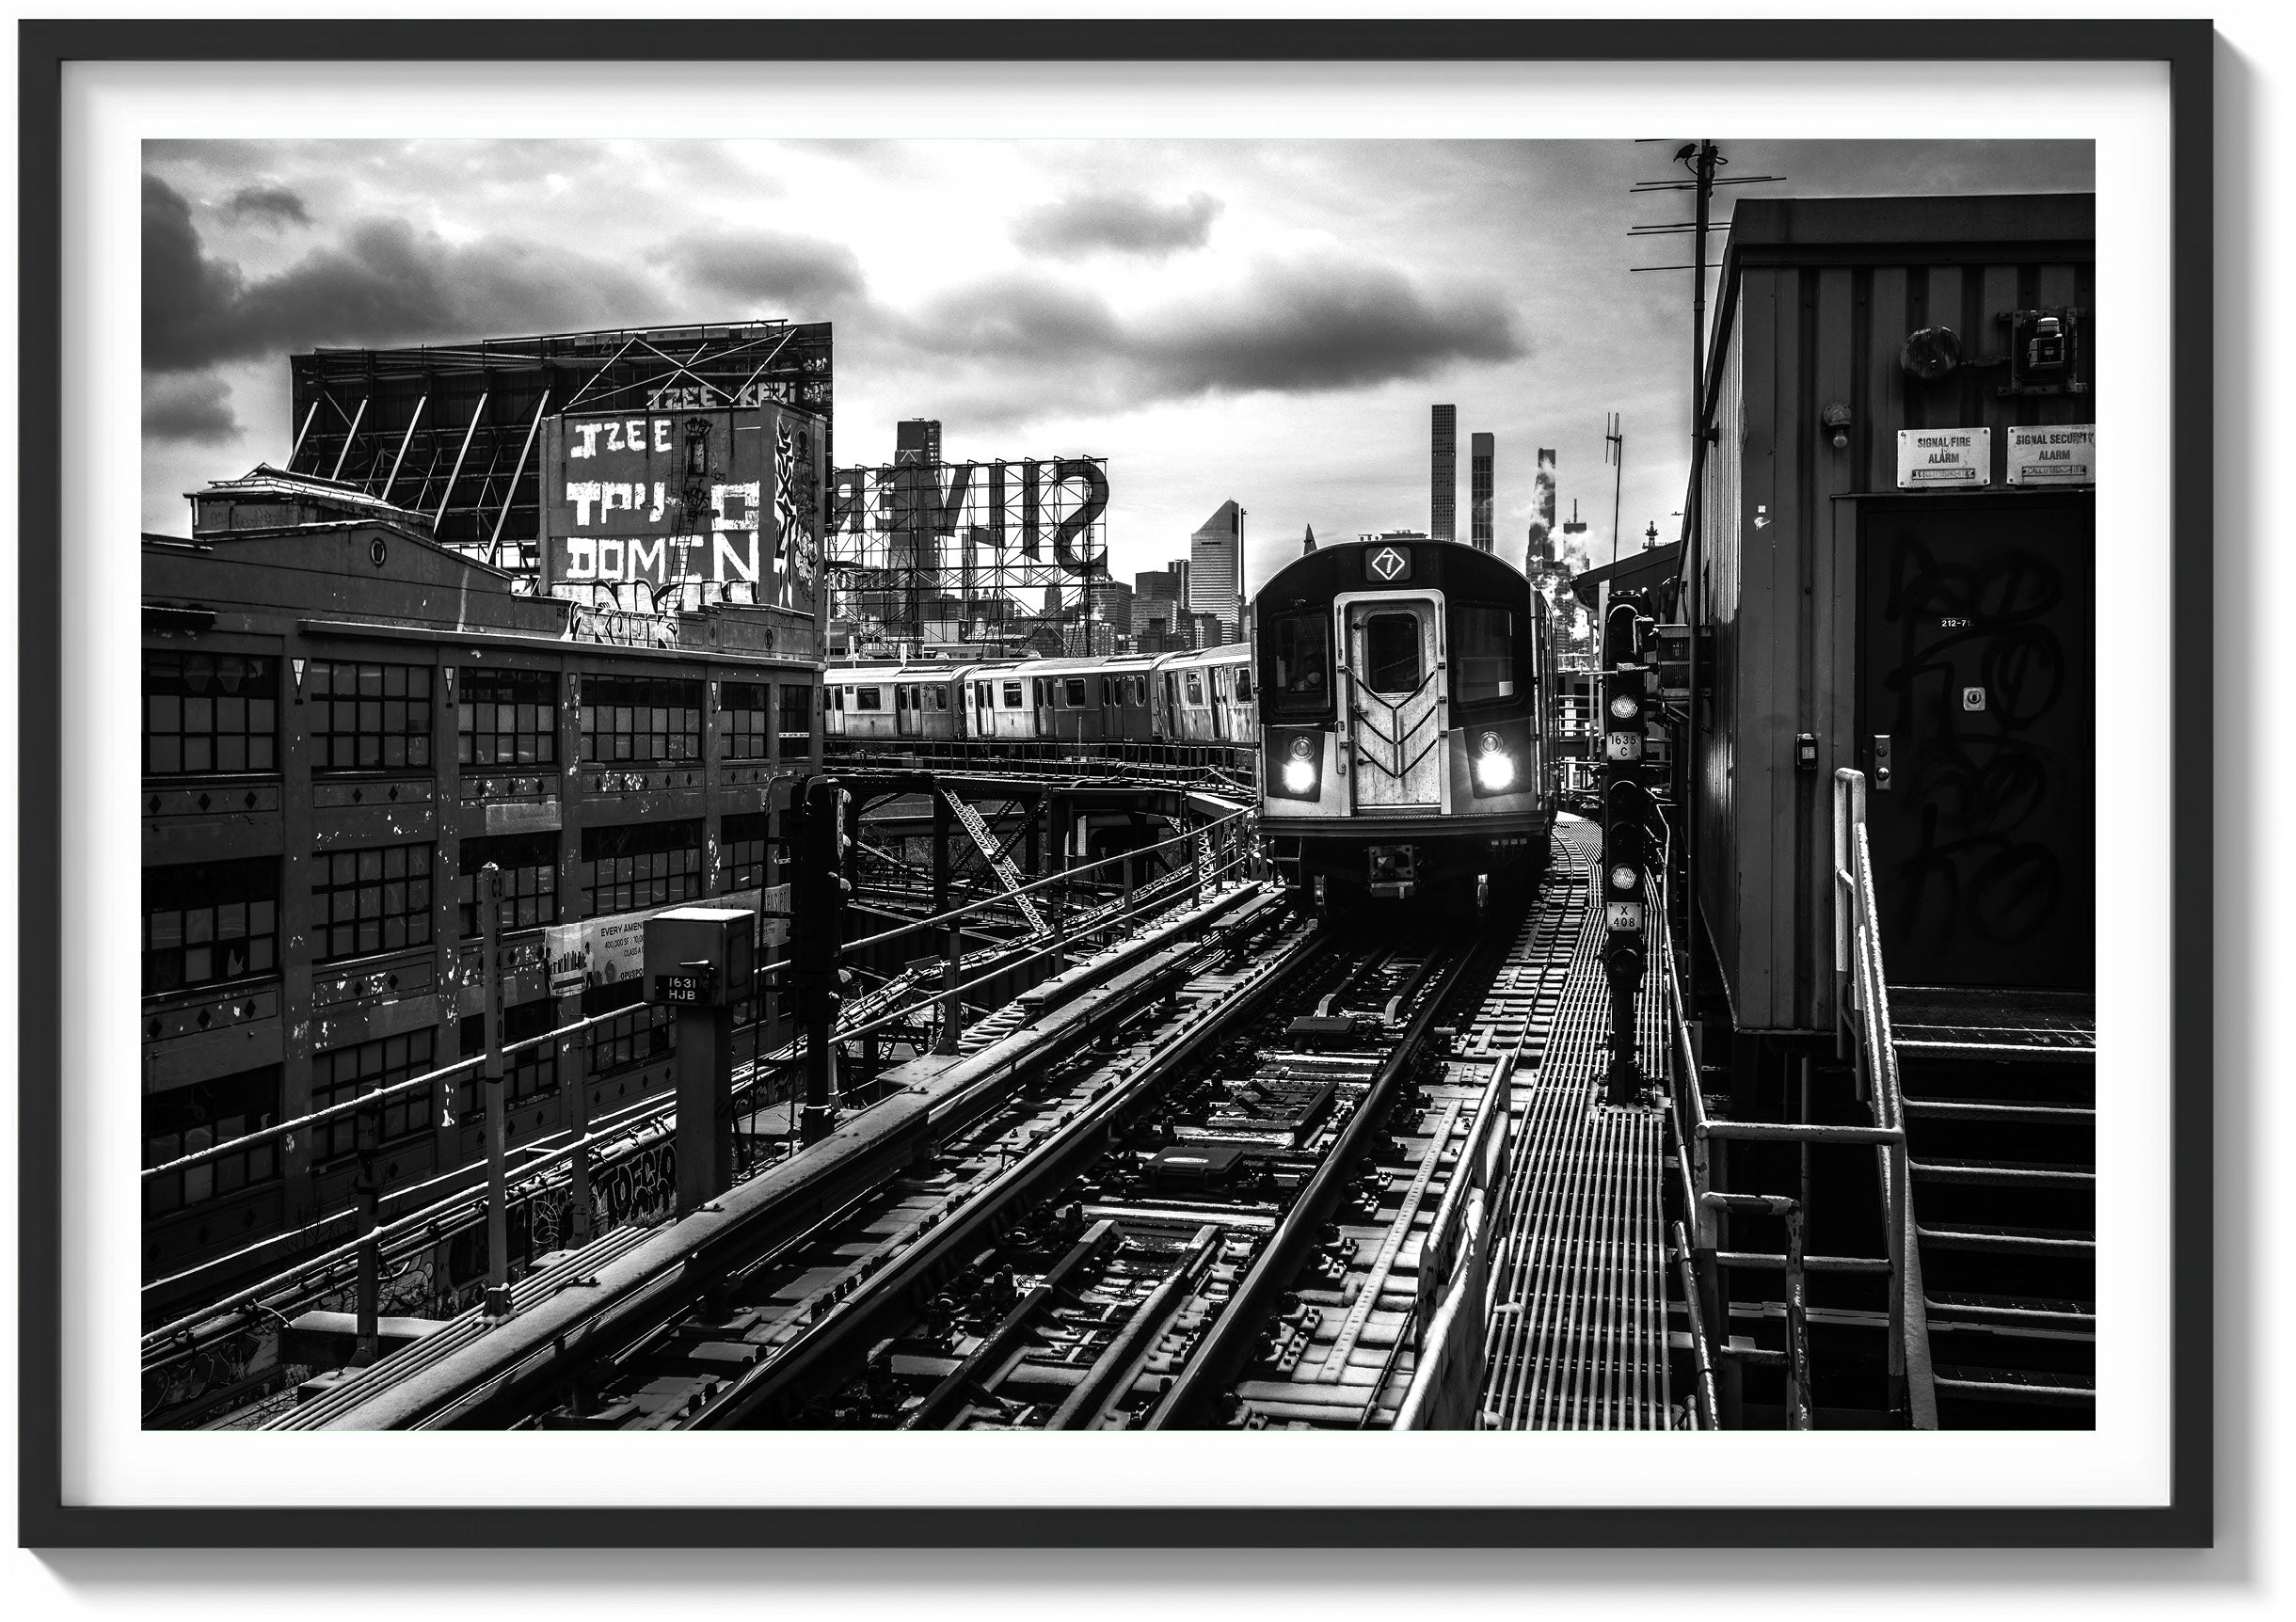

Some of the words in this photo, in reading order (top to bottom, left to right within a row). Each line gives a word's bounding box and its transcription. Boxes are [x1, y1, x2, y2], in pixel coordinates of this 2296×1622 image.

[1917, 437, 1947, 448] SIGNAL
[1951, 437, 1970, 447] FIRE
[2016, 435, 2048, 445] SIGNAL
[1928, 453, 1959, 464] ALARM
[2038, 450, 2070, 460] ALARM
[1382, 554, 1394, 574] 7
[1941, 619, 1973, 628] 212-71
[1611, 735, 1636, 744] 1635
[1620, 747, 1628, 756] C
[491, 878, 502, 898] C2
[1620, 905, 1628, 915] X
[1613, 917, 1635, 927] 408
[600, 925, 622, 937] EVERY
[624, 922, 644, 932] AMEN
[604, 939, 623, 949] 400,000
[624, 946, 638, 958] CLASS
[669, 978, 696, 989] 1631
[668, 989, 696, 1000] HJB
